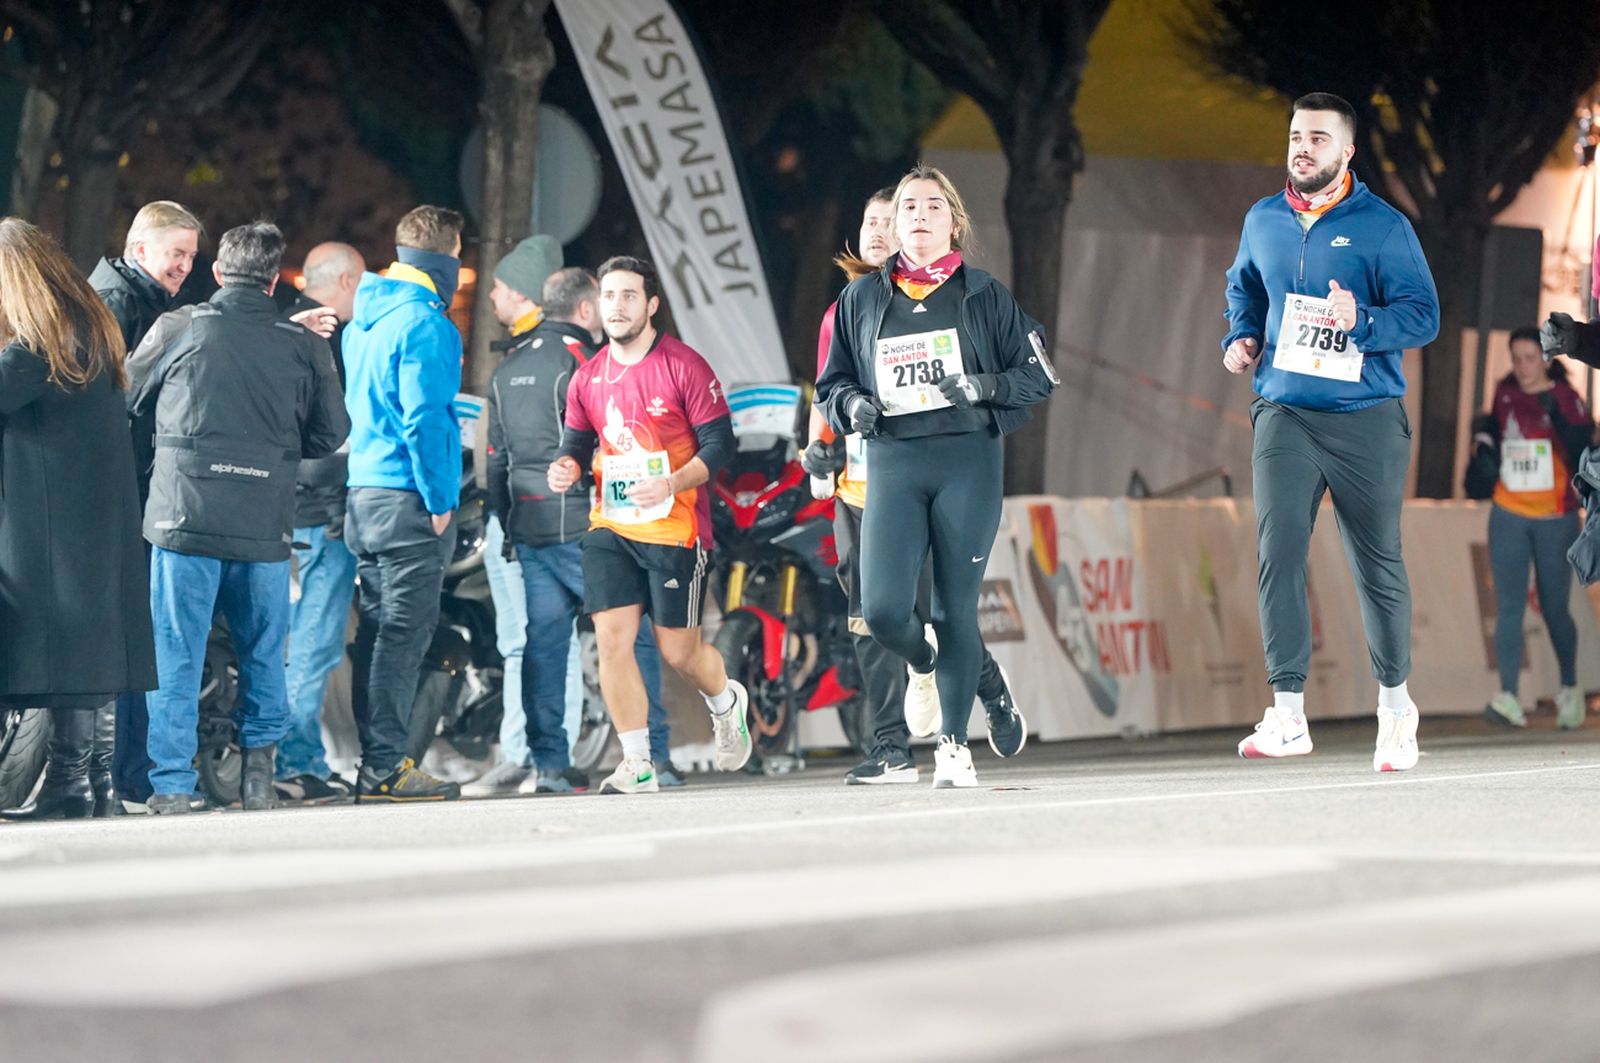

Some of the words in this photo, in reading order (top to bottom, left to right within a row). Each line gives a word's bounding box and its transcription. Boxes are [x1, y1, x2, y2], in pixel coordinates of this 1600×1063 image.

[634, 14, 759, 297] JAPEMASA
[890, 344, 915, 354] NOCHE
[1296, 324, 1349, 353] 2739
[882, 356, 899, 366] SAN
[893, 358, 946, 388] 2738
[1081, 559, 1132, 612] SAN
